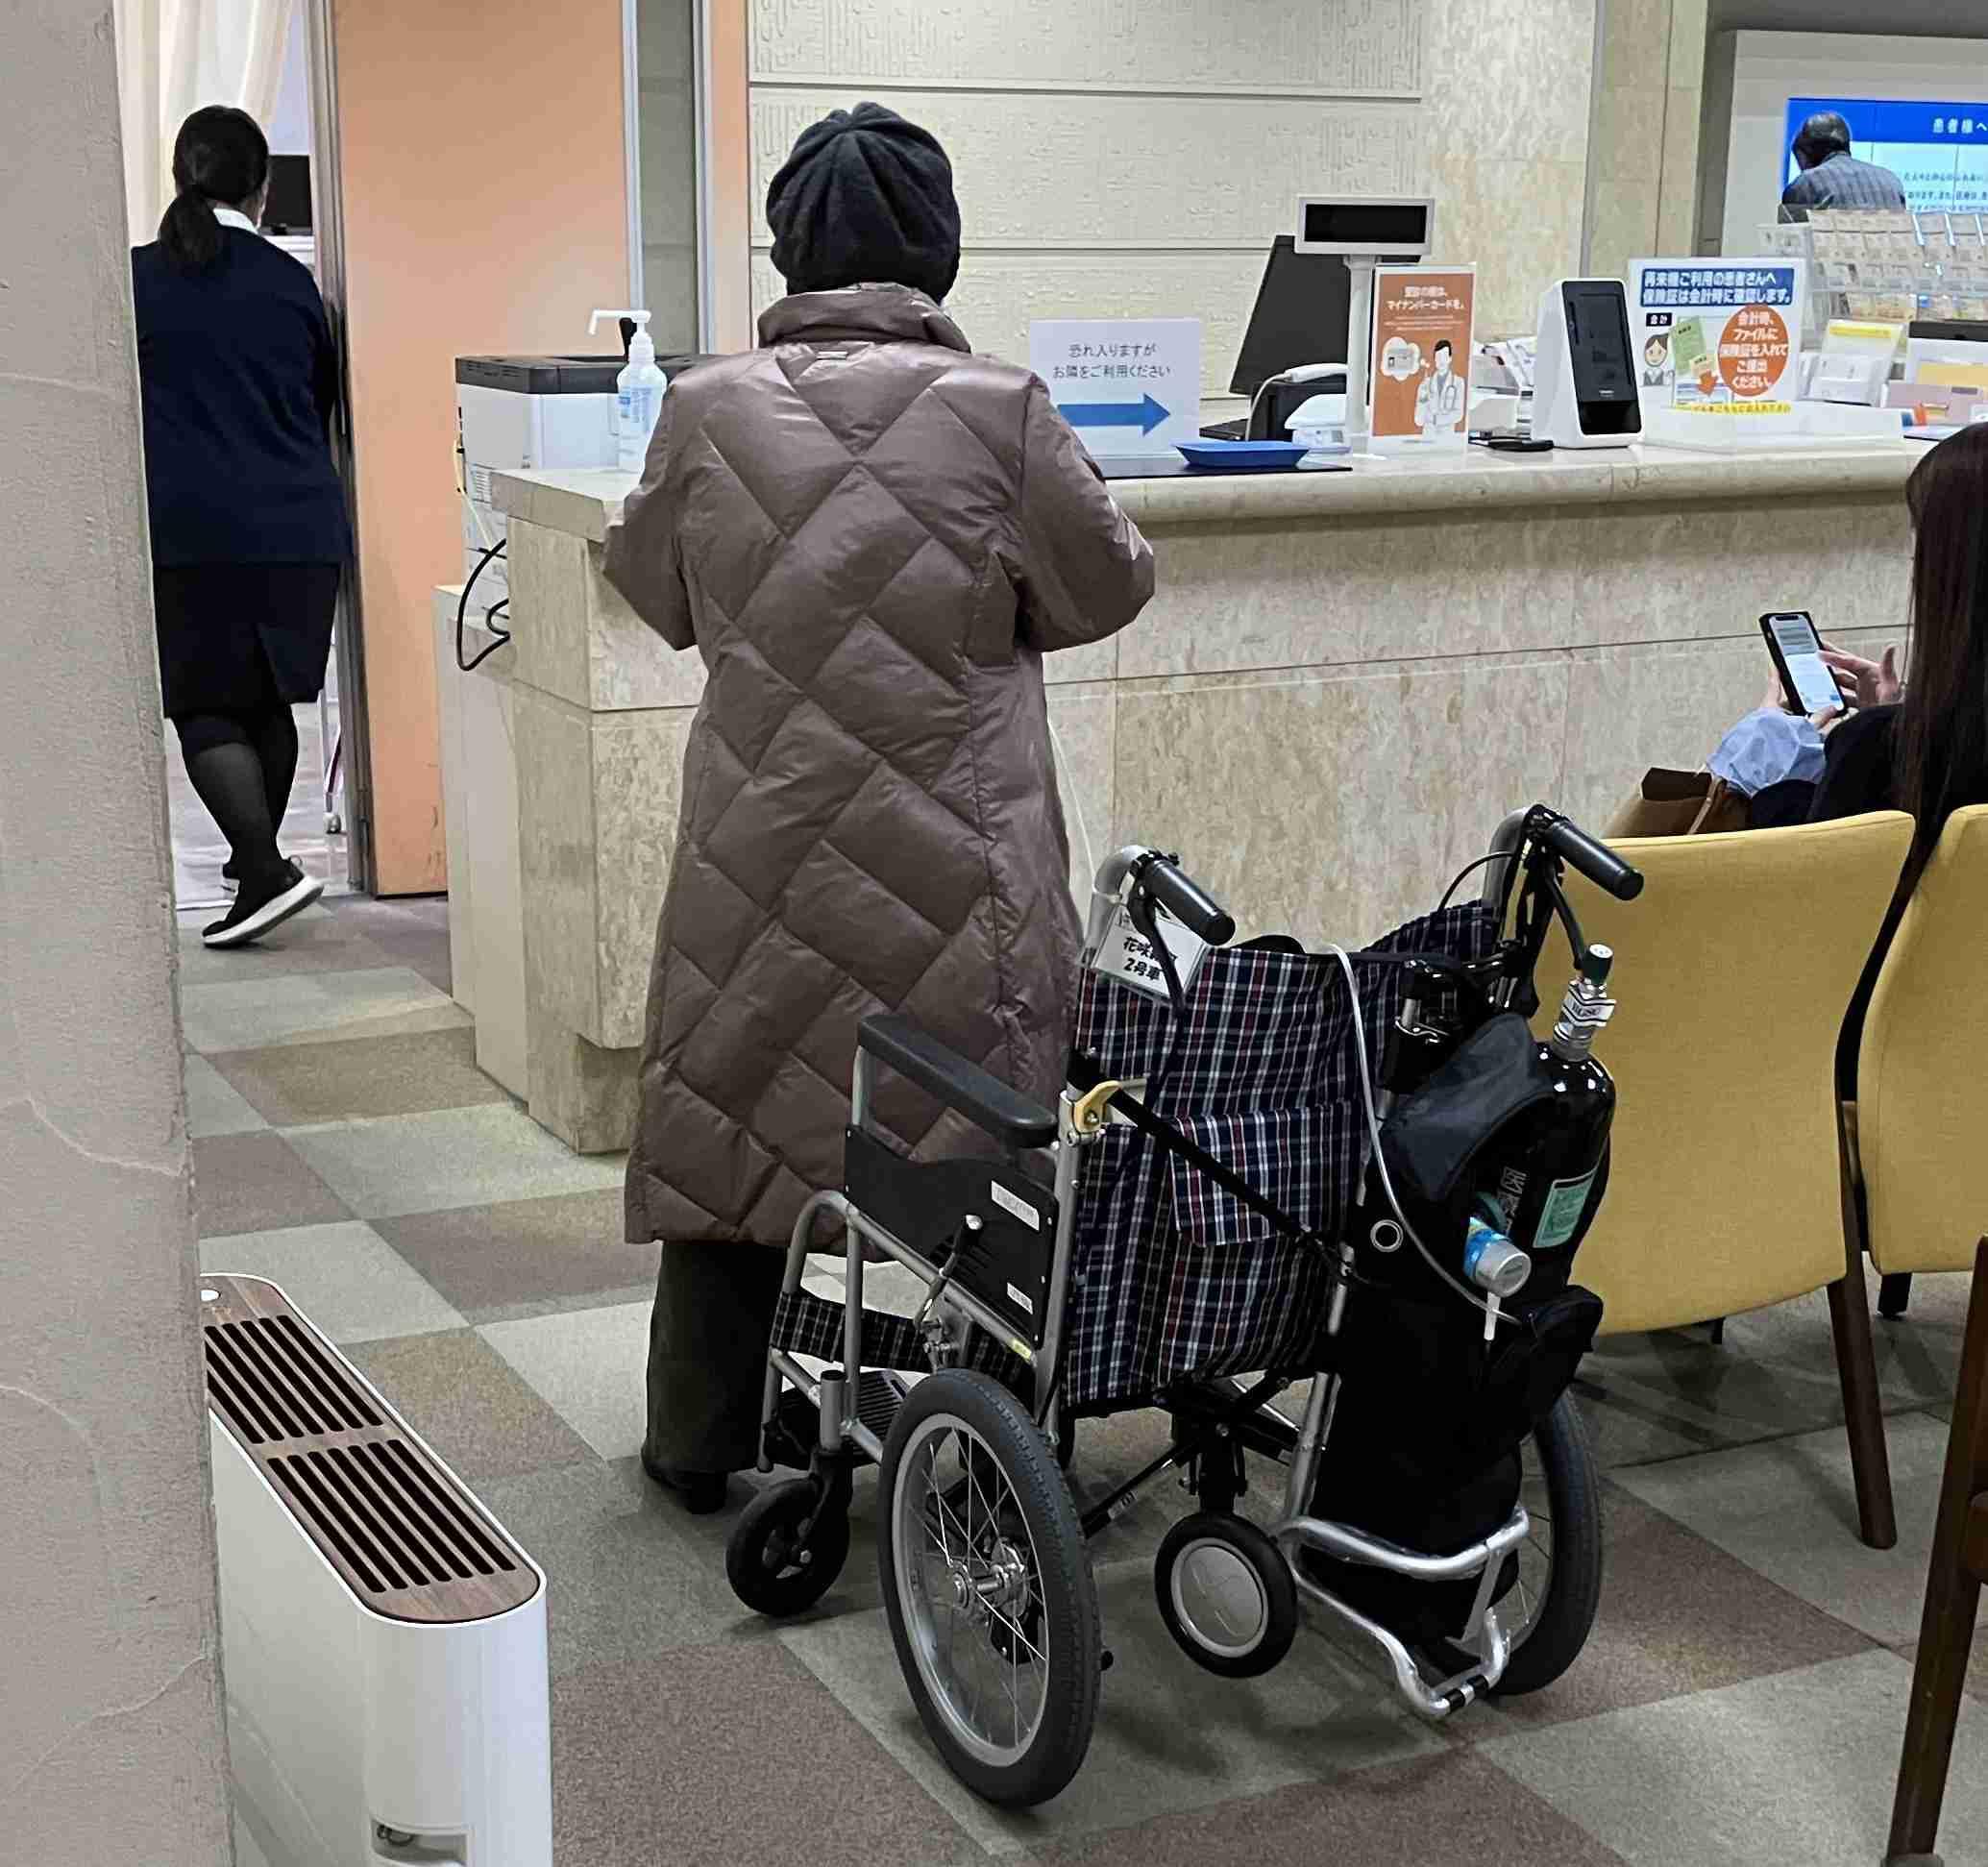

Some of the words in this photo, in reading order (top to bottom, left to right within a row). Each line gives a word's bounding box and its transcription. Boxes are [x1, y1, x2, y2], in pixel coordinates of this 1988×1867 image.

[1732, 328, 1779, 341] ファイルに
[1068, 343, 1157, 357] 恐れ入りますが
[1053, 364, 1171, 379] お隣をご利用ください
[1122, 957, 1166, 980] 2号車
